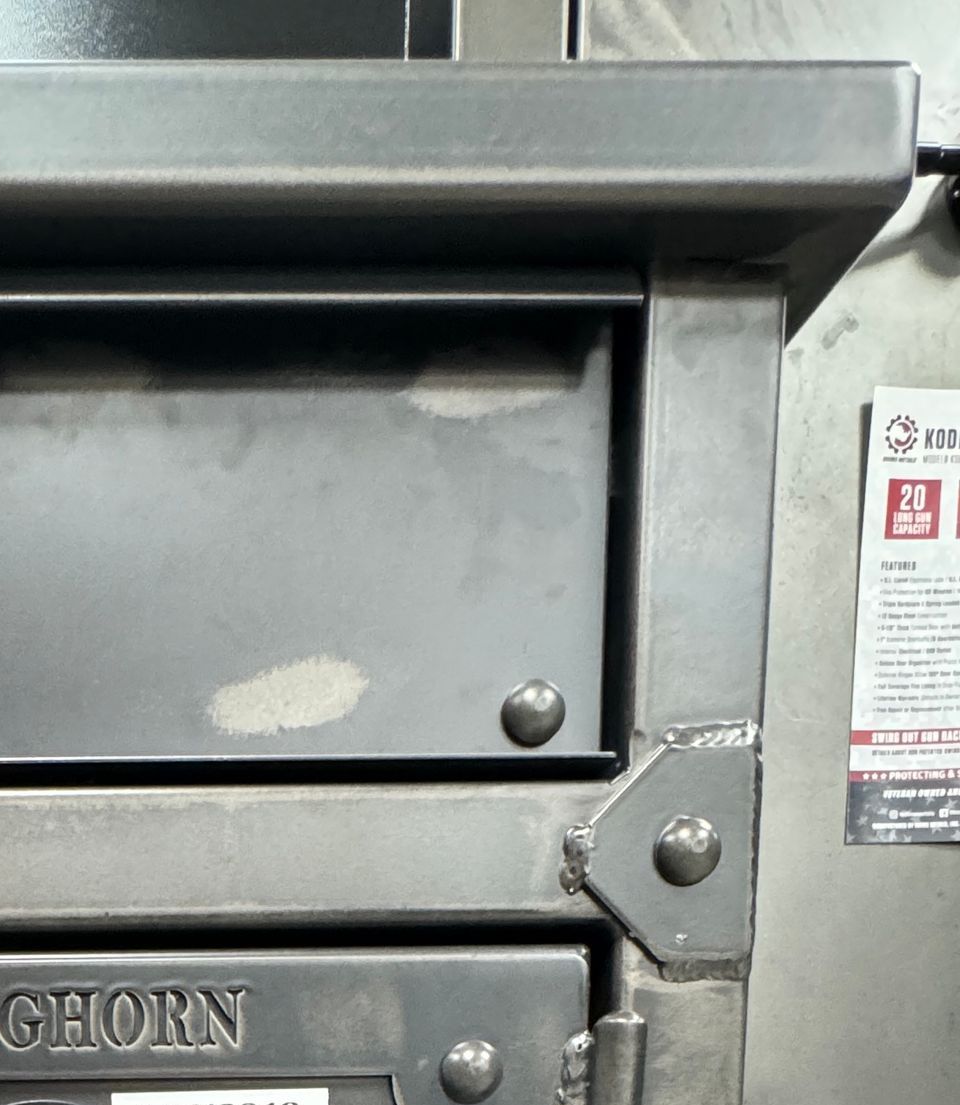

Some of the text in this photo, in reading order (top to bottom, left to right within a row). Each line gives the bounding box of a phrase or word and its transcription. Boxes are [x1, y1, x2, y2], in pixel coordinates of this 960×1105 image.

[924, 428, 960, 450] KOD
[899, 484, 927, 511] 20
[892, 511, 913, 523] LONG
[892, 524, 931, 535] CAPACITY
[871, 731, 900, 744] SWING
[901, 731, 920, 743] OUT
[941, 730, 960, 742] RAC
[888, 770, 947, 781] PROTECTING
